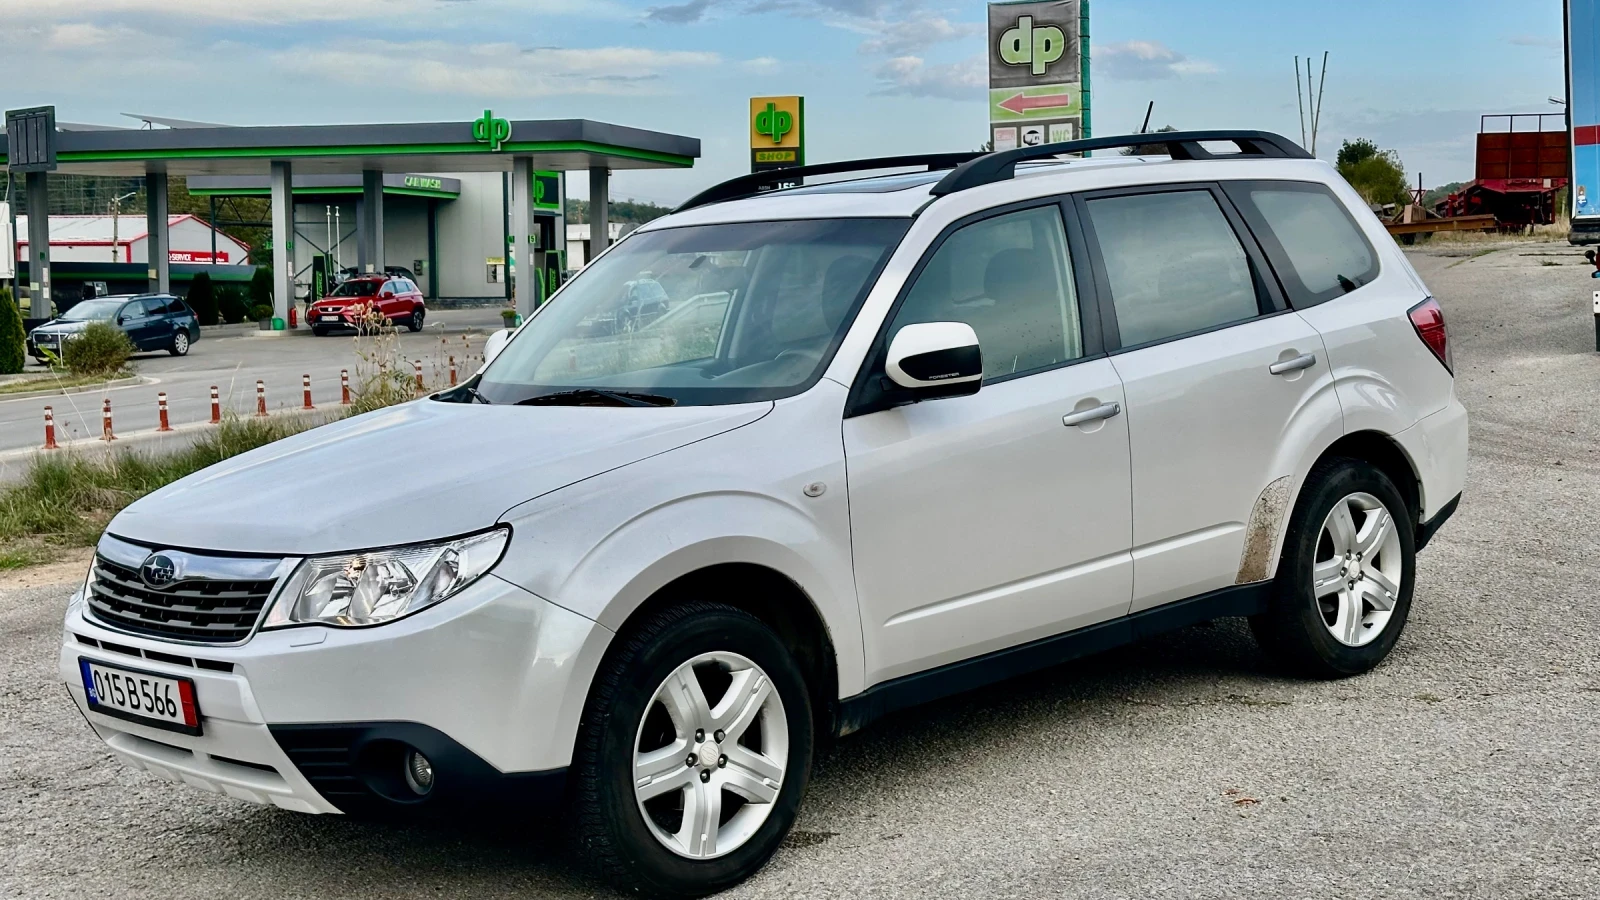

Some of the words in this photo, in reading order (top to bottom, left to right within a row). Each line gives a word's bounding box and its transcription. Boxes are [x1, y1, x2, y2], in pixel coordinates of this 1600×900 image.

[998, 15, 1066, 76] dp
[472, 109, 511, 150] dp
[755, 102, 793, 143] dp
[1051, 129, 1071, 143] WC
[758, 152, 793, 161] SHOP
[928, 372, 960, 380] FORESTER
